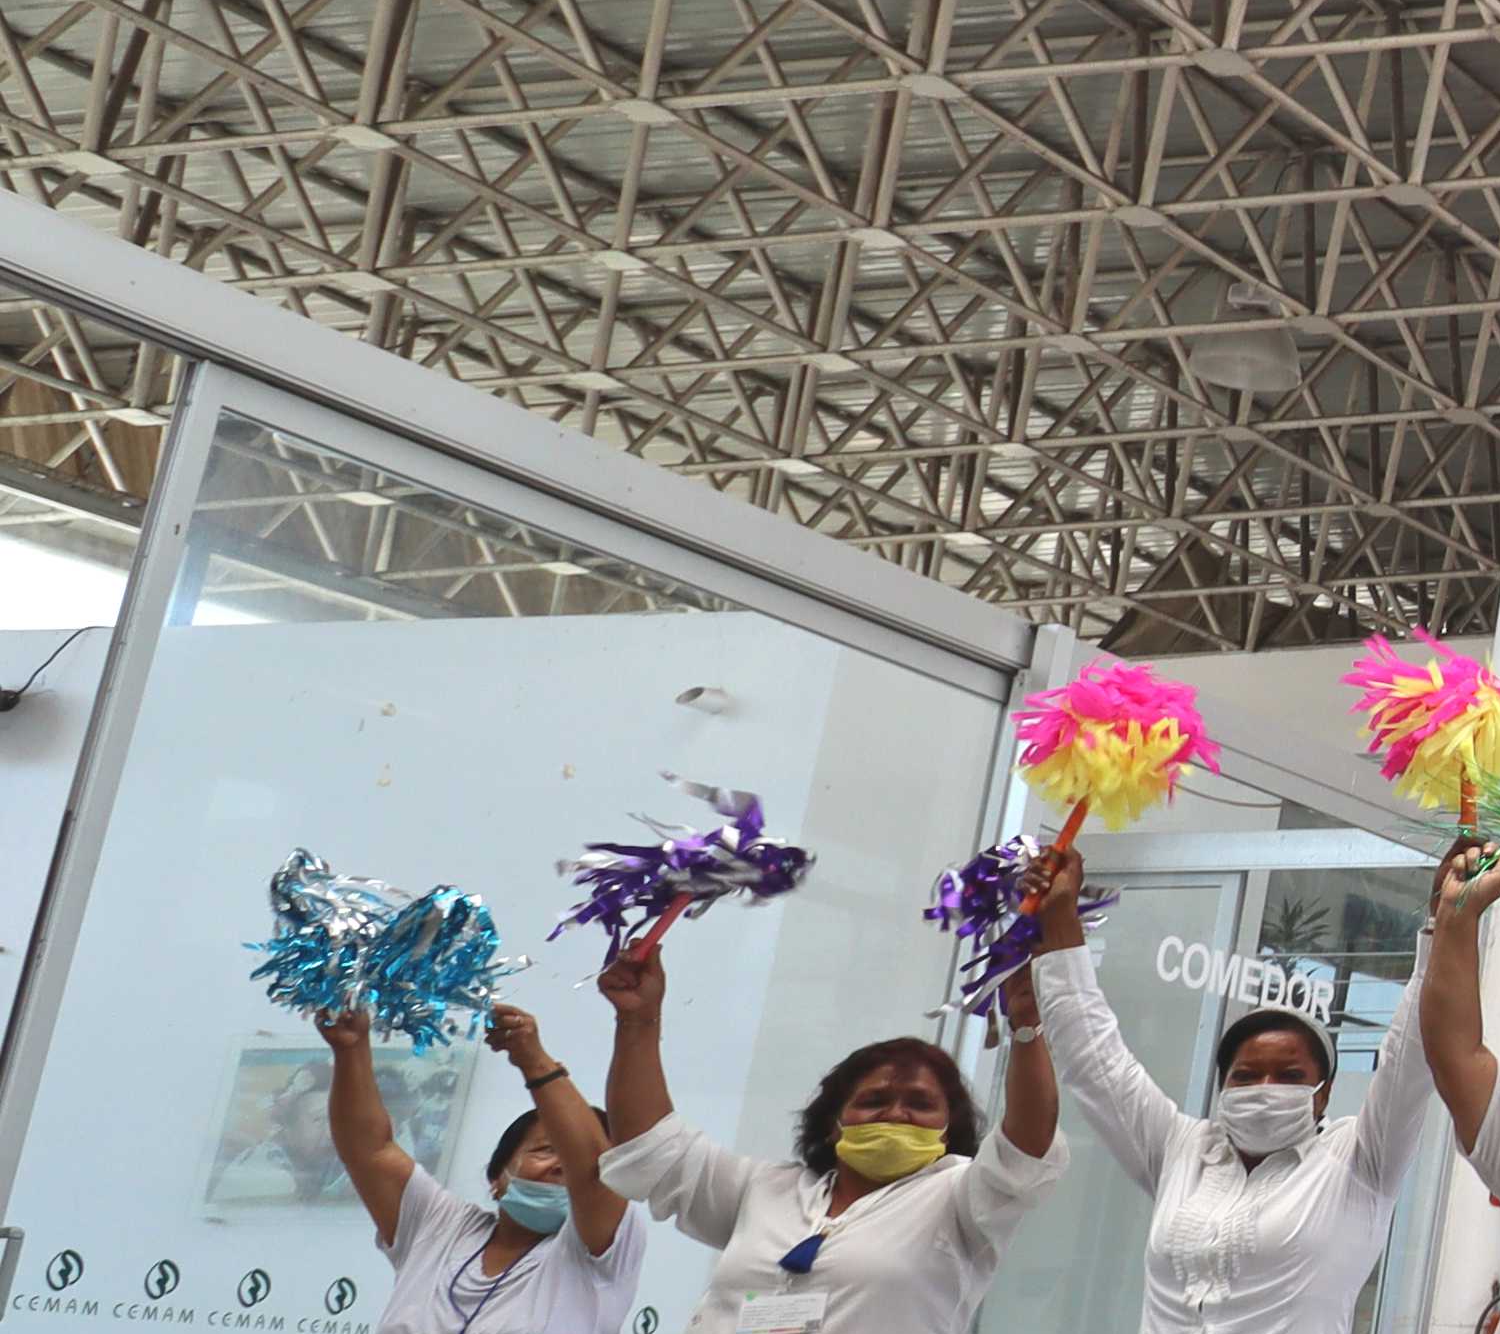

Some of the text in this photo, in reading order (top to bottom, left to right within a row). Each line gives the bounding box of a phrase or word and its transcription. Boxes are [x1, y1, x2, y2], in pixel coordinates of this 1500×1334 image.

[1156, 935, 1334, 1025] COMEDOR
[12, 1293, 99, 1316] CEMAM
[112, 1301, 195, 1325] CEMAM
[207, 1309, 285, 1332] CEMAM
